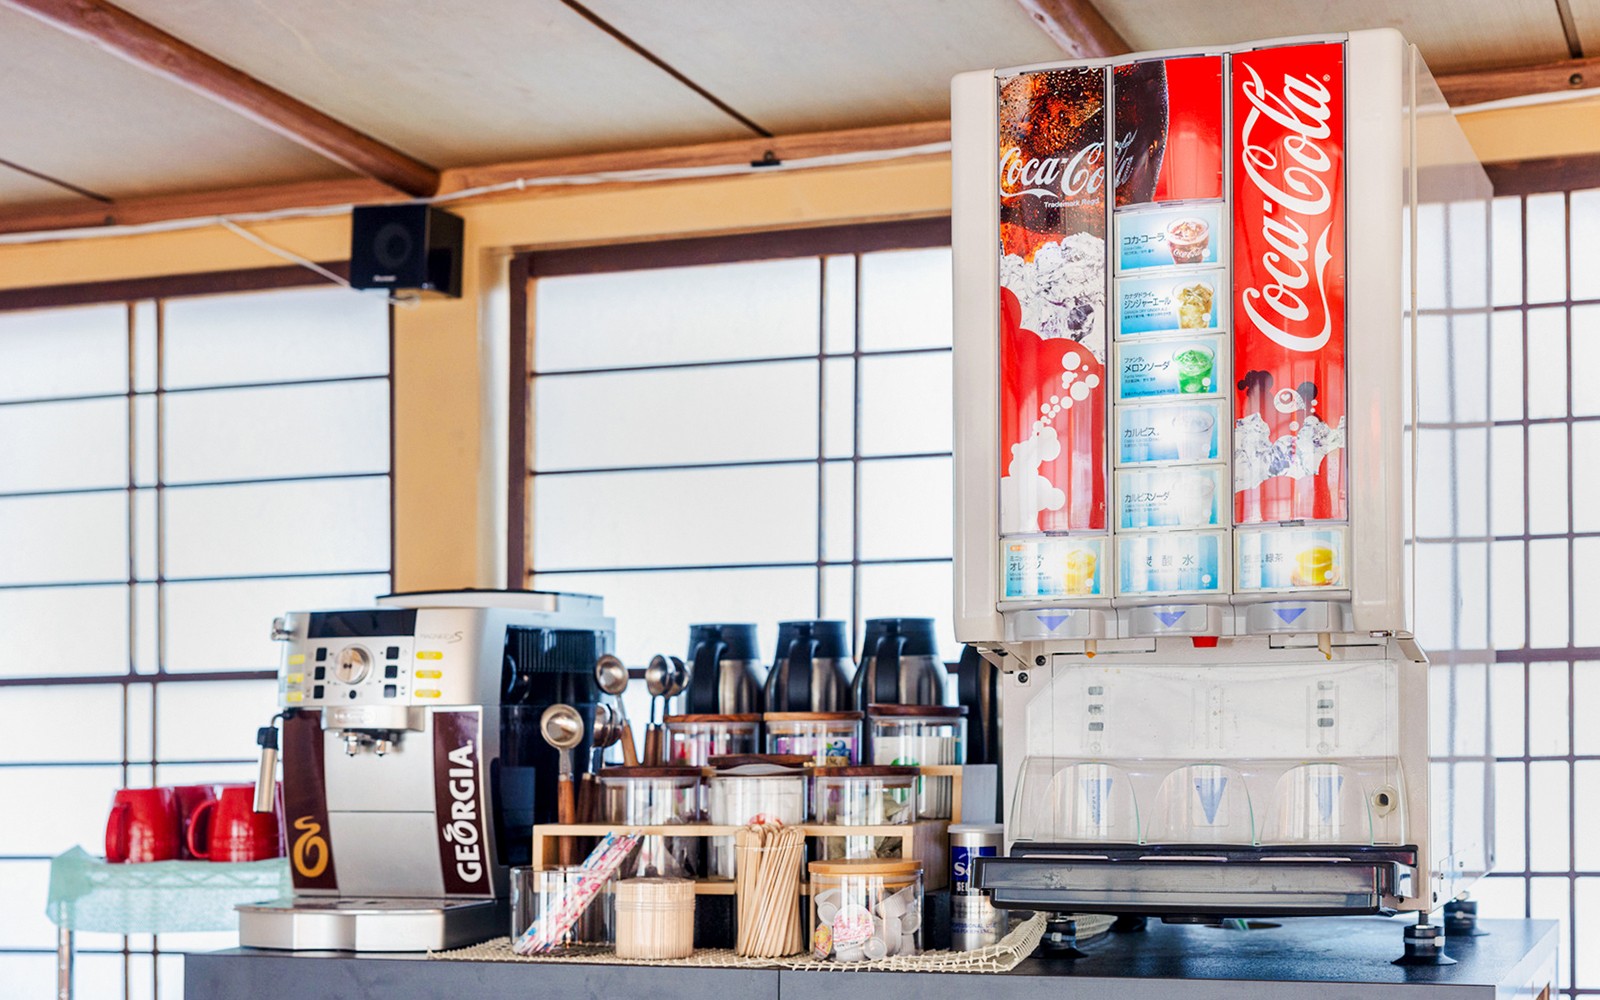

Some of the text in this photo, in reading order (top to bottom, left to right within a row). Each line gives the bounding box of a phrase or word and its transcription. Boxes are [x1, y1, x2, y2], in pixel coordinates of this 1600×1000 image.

[1241, 61, 1333, 352] Coca-Cola
[1124, 297, 1171, 310] ジンジャーエール
[1124, 360, 1171, 374] メロンソーダ
[443, 742, 482, 883] GEORGIA
